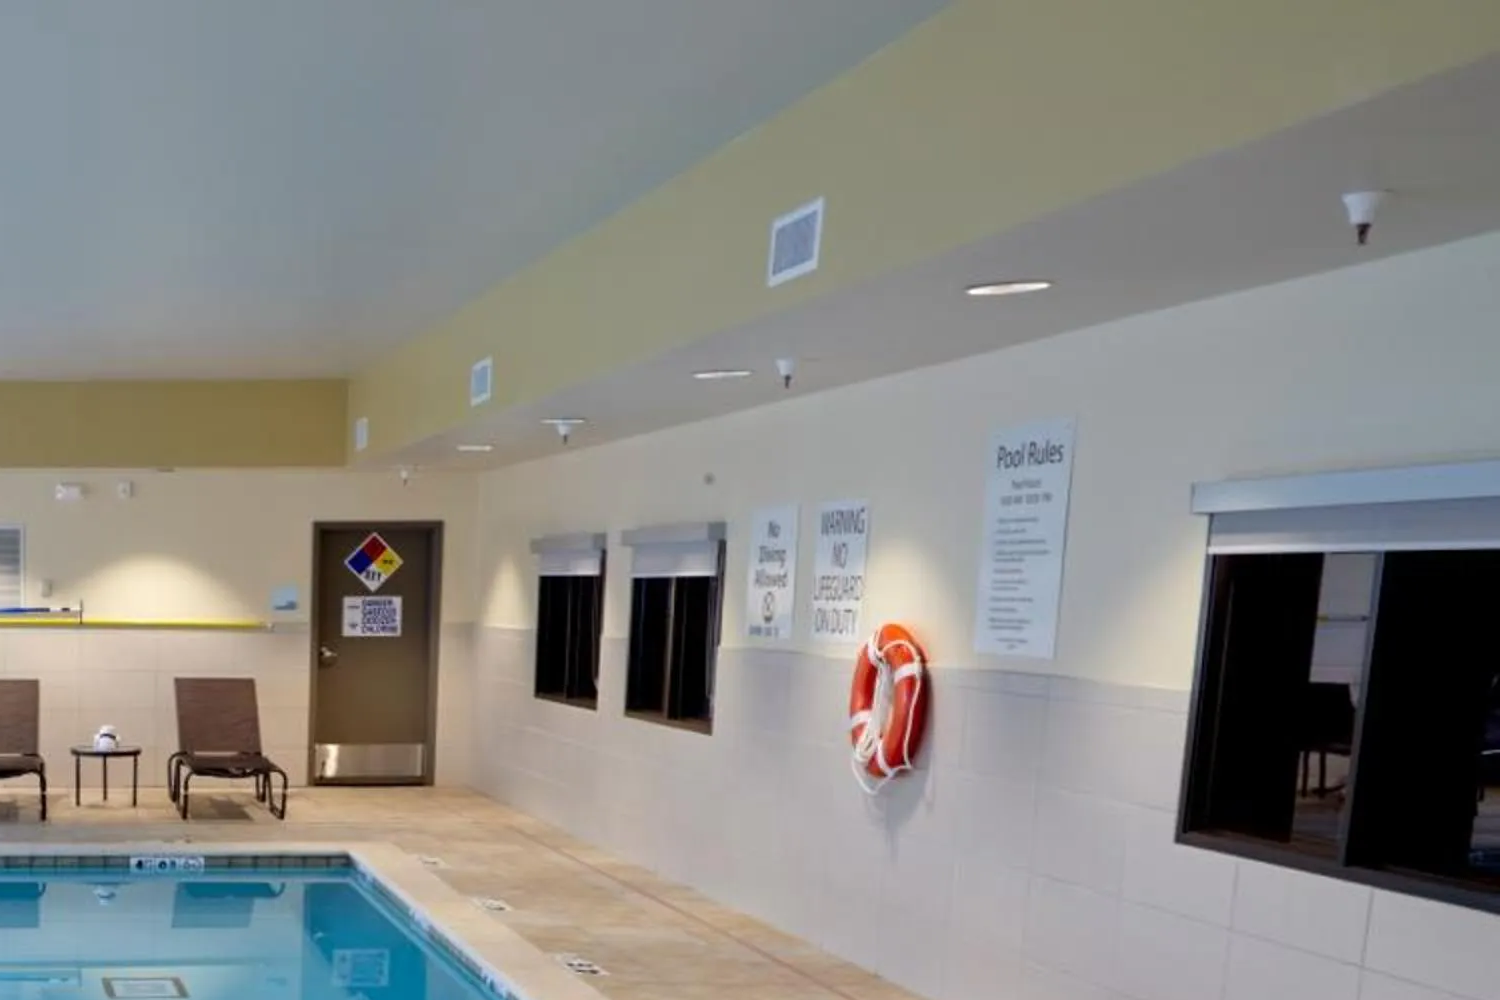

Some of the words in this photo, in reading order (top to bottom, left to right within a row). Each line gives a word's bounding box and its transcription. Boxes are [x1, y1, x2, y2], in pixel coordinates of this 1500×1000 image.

[996, 441, 1026, 469] Pool
[1028, 439, 1065, 465] Rules
[767, 520, 780, 538] No
[821, 507, 865, 535] WARNING
[758, 545, 786, 568] Diving
[754, 568, 787, 588] Allowed
[813, 574, 865, 601] LIFEGUARD
[815, 607, 830, 633] ON
[830, 608, 858, 635] DUTY
